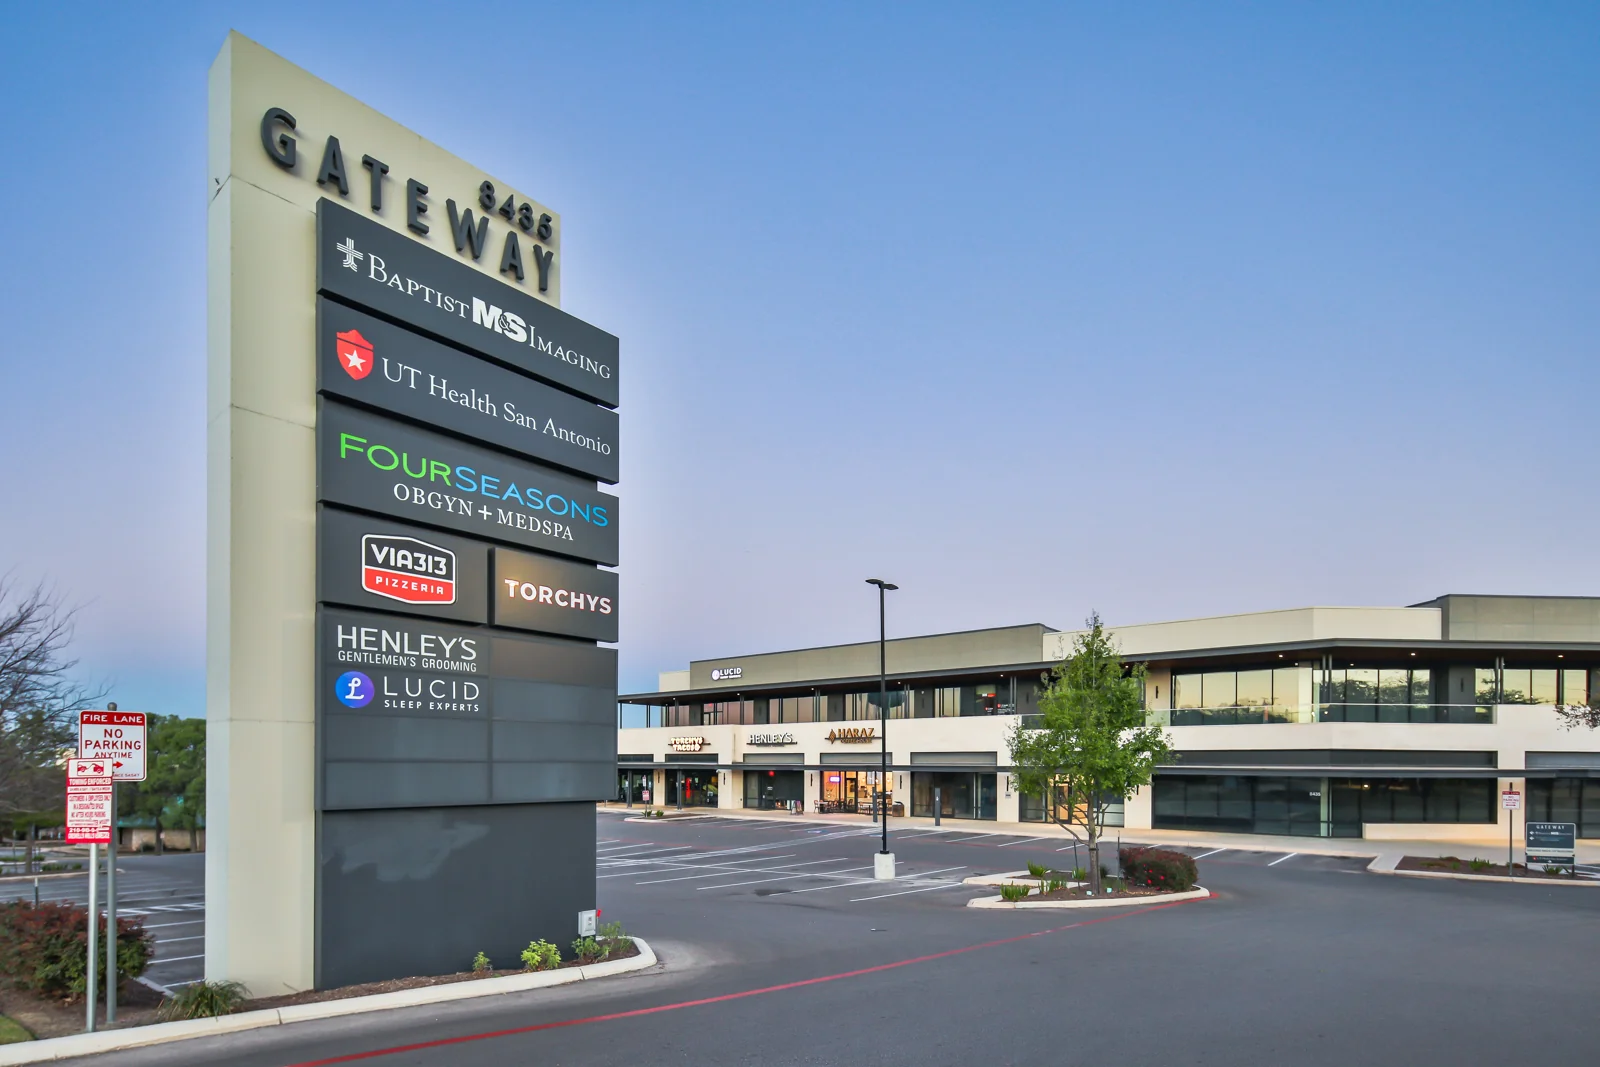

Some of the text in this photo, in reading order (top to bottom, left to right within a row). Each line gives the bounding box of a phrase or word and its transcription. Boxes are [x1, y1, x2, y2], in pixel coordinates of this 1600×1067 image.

[260, 107, 554, 292] GATEWAY
[478, 180, 553, 241] 8435
[368, 252, 470, 319] BAPTIST
[529, 324, 611, 380] IMAGING
[382, 357, 611, 456] UT Health San Antonio
[393, 483, 473, 517] OBGYN
[496, 507, 574, 541] MEDSPA
[375, 575, 444, 595] PIZZERIA
[504, 578, 612, 615] TORCHYS
[337, 624, 477, 661] HENLEY'S
[338, 650, 477, 673] GENTLEMEN'S GROOMING
[720, 667, 742, 676] LUCID
[383, 675, 480, 701] LUCID
[384, 699, 480, 713] SLEEP EXPERTS
[82, 713, 143, 724] FIRE LANE
[104, 728, 123, 739] NO
[749, 732, 793, 744] HENLEY'S
[837, 727, 875, 738] HARAZ
[84, 739, 142, 750] PARKING
[93, 751, 133, 759] ANYTIME
